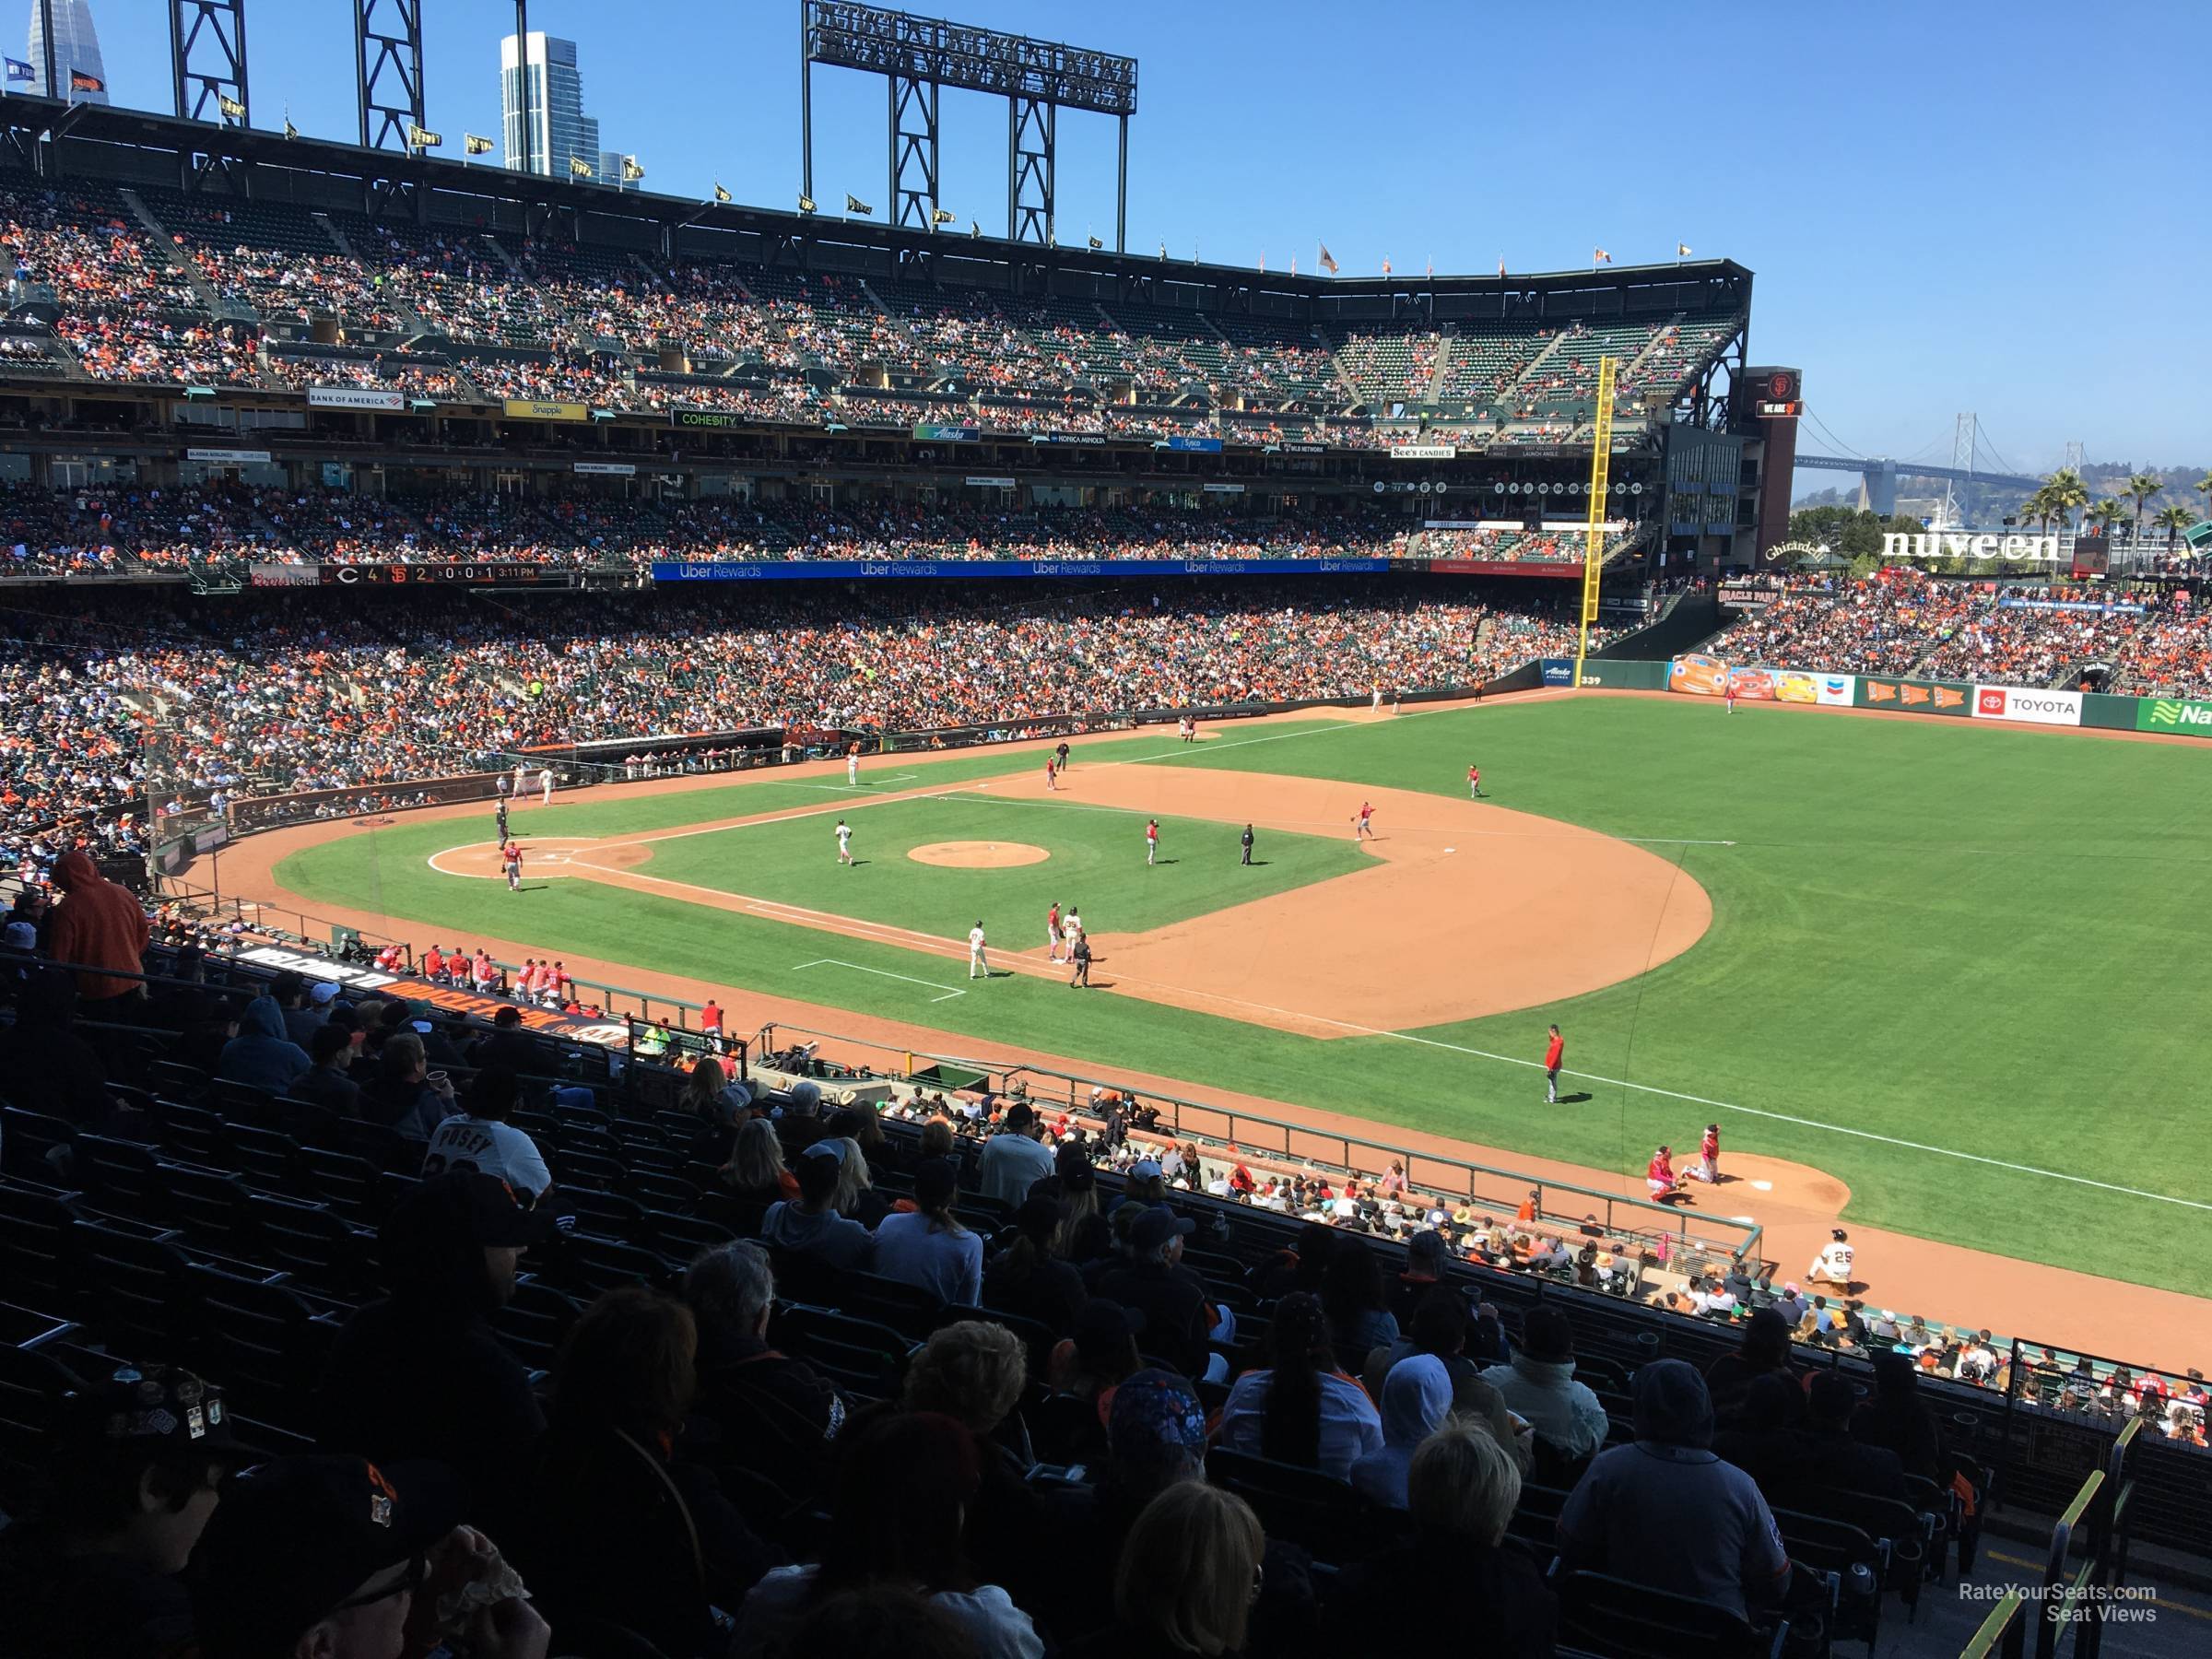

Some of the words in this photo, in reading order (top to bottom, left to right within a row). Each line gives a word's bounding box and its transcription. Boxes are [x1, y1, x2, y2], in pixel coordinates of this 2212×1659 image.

[311, 394, 334, 404] BANK
[347, 396, 385, 406] AMERICA
[532, 404, 562, 415] Snapple
[1764, 404, 1774, 413] WE
[1774, 404, 1786, 413] ARE
[682, 413, 736, 427] COHESITY
[934, 427, 964, 440] Alaska
[1058, 435, 1081, 443] KONICA
[1081, 436, 1105, 444] MINOLTA
[1184, 439, 1201, 448] Sysco
[1394, 447, 1417, 456] See's
[1418, 449, 1452, 457] CANDIES
[1764, 537, 1824, 563] Ghirardelli
[1880, 531, 2060, 561] nuveen
[679, 564, 712, 578] Uber
[713, 564, 761, 577] Rewards
[860, 562, 889, 575] Uber
[891, 562, 937, 575] Rewards
[1032, 561, 1059, 574] Uber
[1061, 561, 1100, 574] Rewards
[1185, 560, 1207, 572] Uber
[1209, 560, 1245, 572] Rewards
[1320, 559, 1341, 571] Uber
[1342, 560, 1373, 571] Rewards
[368, 570, 377, 581] 4
[416, 569, 426, 582] 2
[445, 567, 454, 579] 0
[465, 567, 474, 579] 0
[486, 567, 492, 579] 1
[498, 568, 518, 578] 3:11
[520, 568, 535, 578] PM
[252, 573, 288, 586] Coors
[288, 577, 320, 586] LIGHT
[1718, 590, 1752, 602] ORACLE
[1753, 591, 1778, 605] PARK
[1545, 666, 1571, 676] Alaska
[2083, 664, 2097, 673] JACK
[1581, 676, 1601, 685] 339
[2012, 698, 2076, 714] TOYOTA
[235, 947, 366, 981] WELCOME
[344, 972, 399, 989] TO
[376, 981, 496, 1012] ORACLE
[438, 1126, 492, 1155] POSEY
[1834, 1251, 1852, 1264] 25
